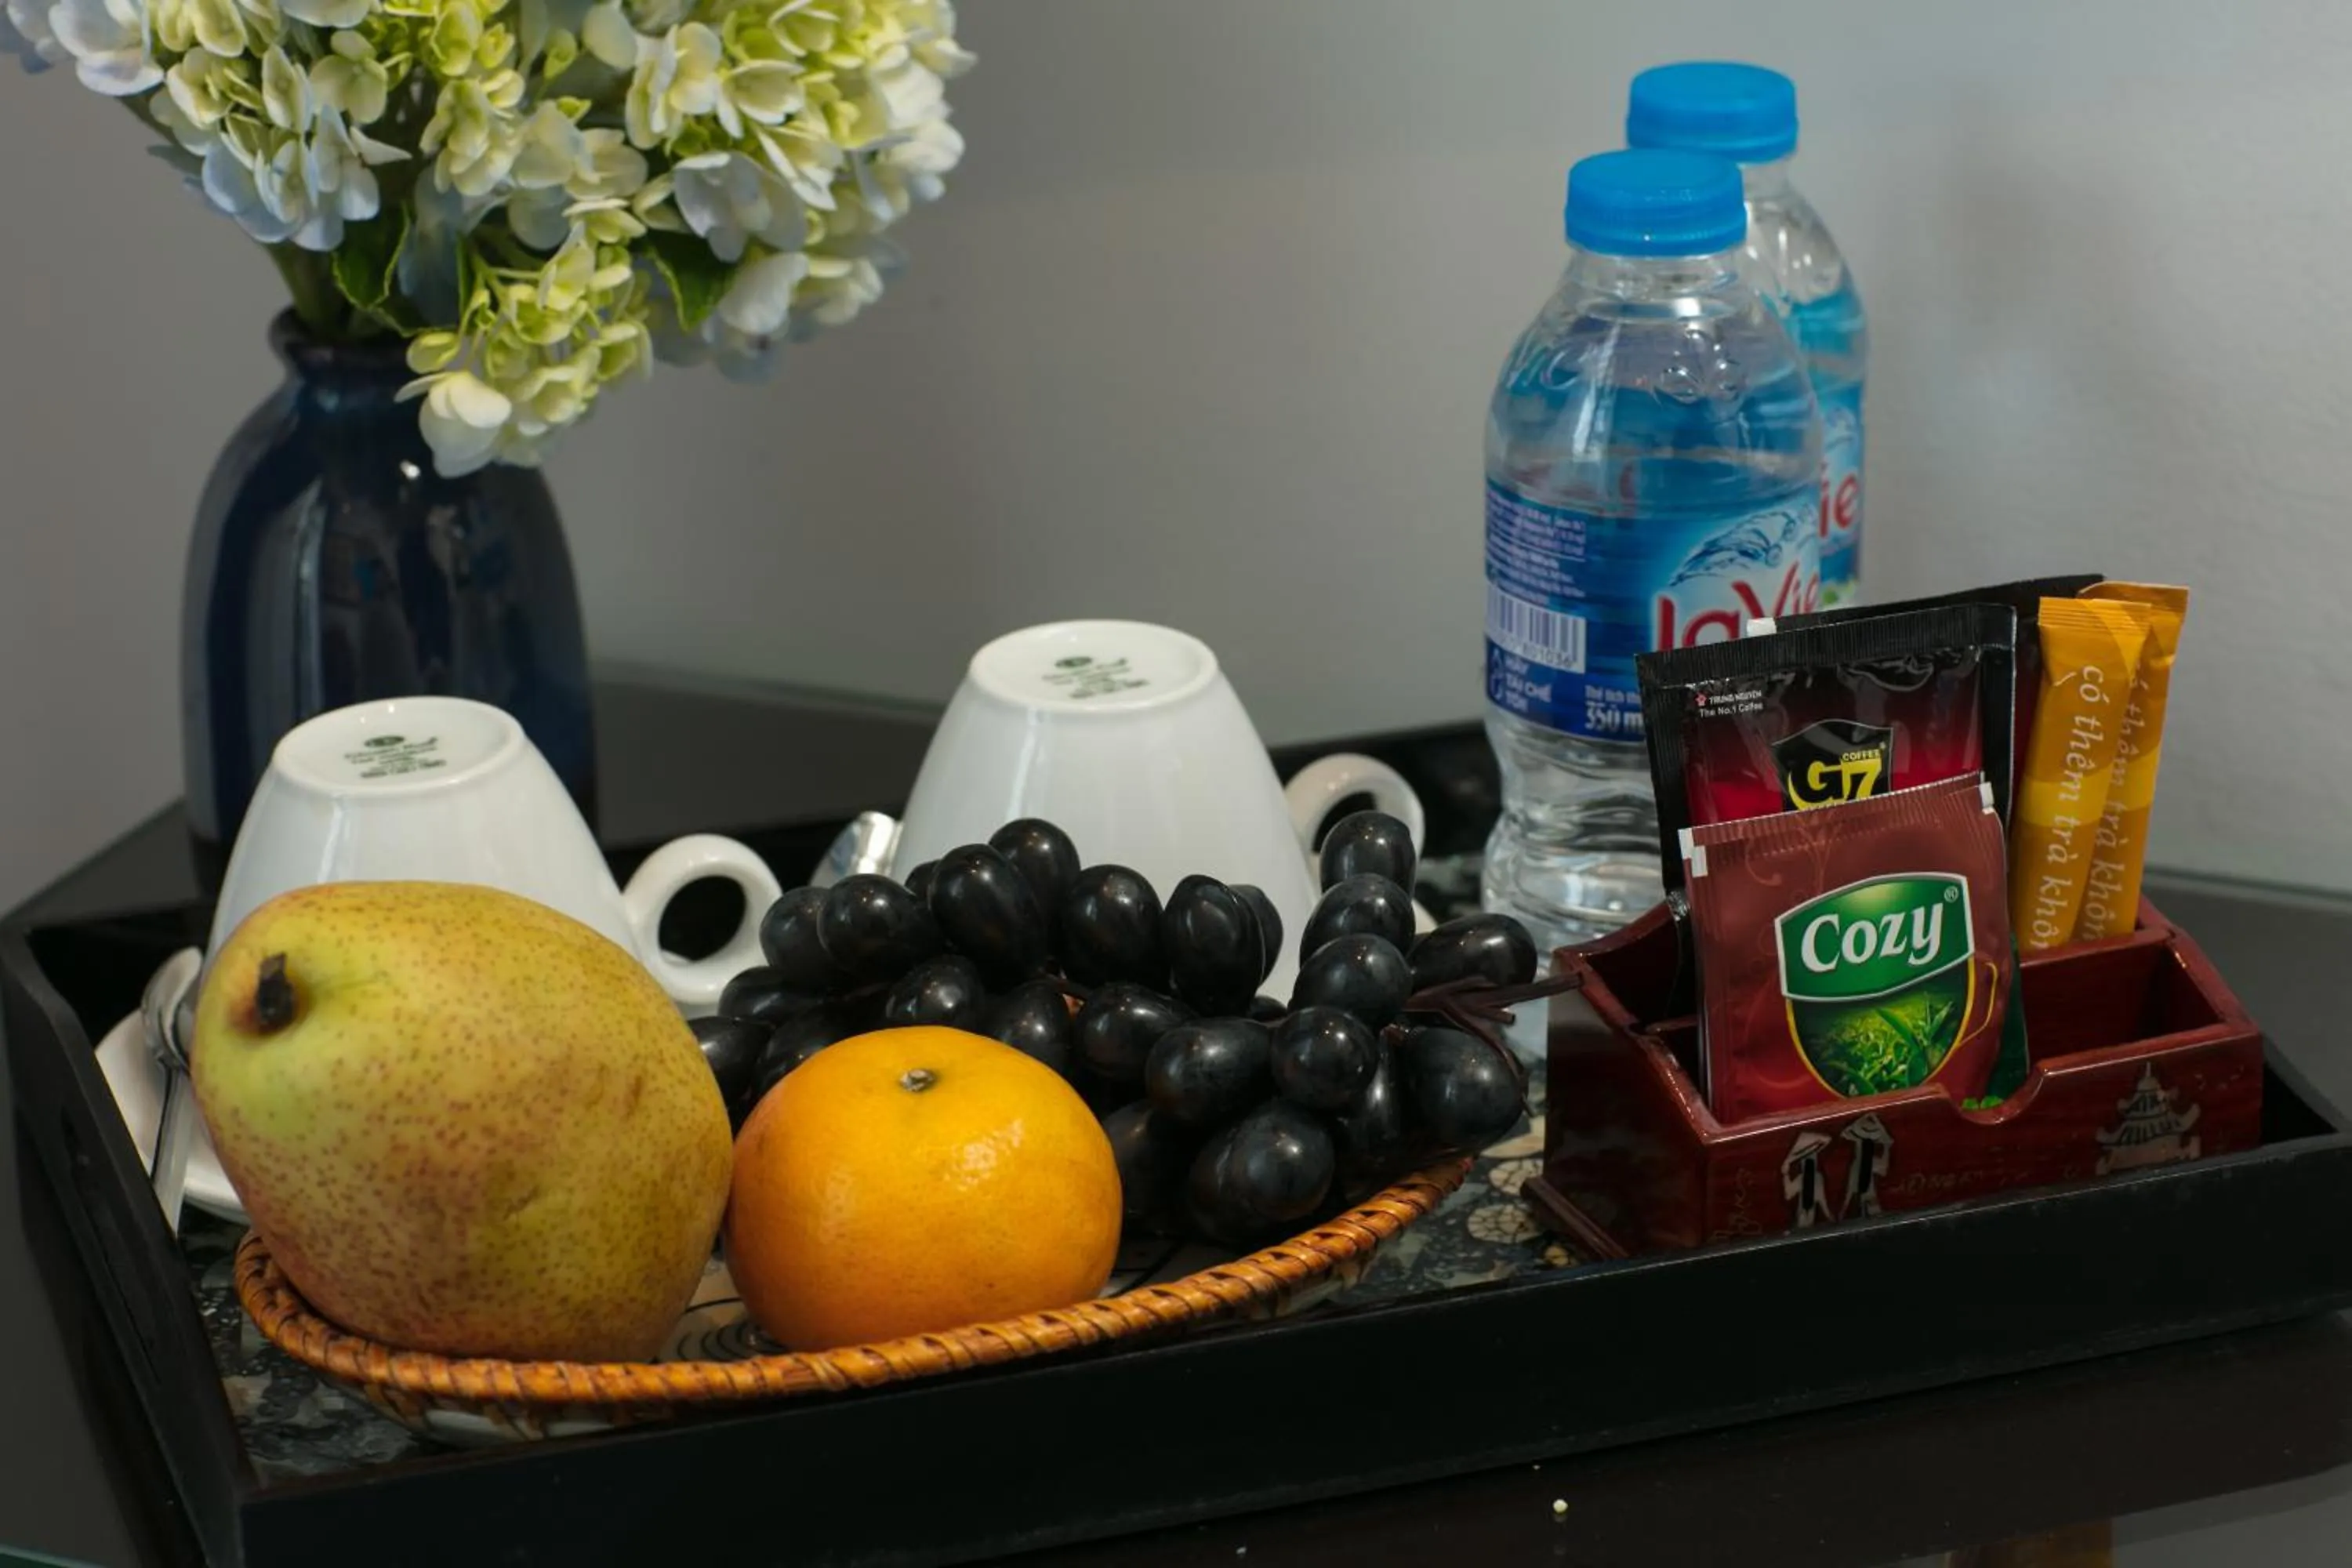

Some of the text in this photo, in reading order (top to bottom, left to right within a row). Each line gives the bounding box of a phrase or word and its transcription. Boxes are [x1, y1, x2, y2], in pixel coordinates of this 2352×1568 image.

[2079, 665, 2111, 704] có
[1699, 708, 1715, 719] The
[1842, 749, 1880, 761] COFFEE
[2057, 714, 2105, 801] thêm
[1788, 757, 1883, 811] G7
[2045, 814, 2080, 864] trà
[1801, 902, 1944, 973] Cozy
